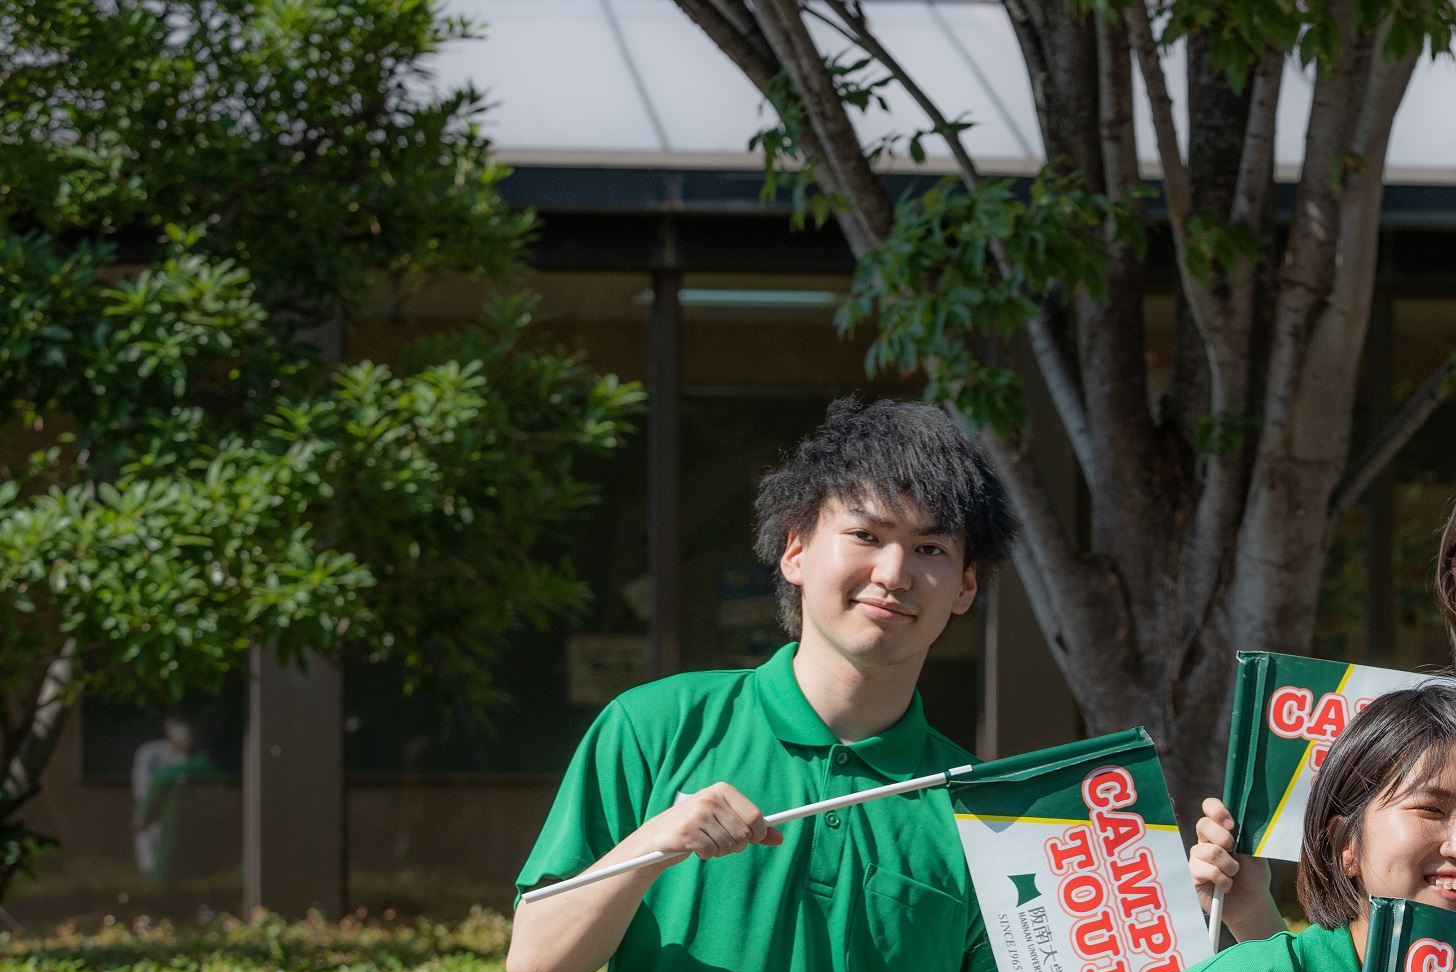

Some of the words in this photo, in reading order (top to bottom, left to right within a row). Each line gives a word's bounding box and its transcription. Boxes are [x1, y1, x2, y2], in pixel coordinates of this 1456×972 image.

[997, 912, 1017, 948] SINCE
[1008, 949, 1023, 971] 1965
[1017, 911, 1034, 943] HANNAN
